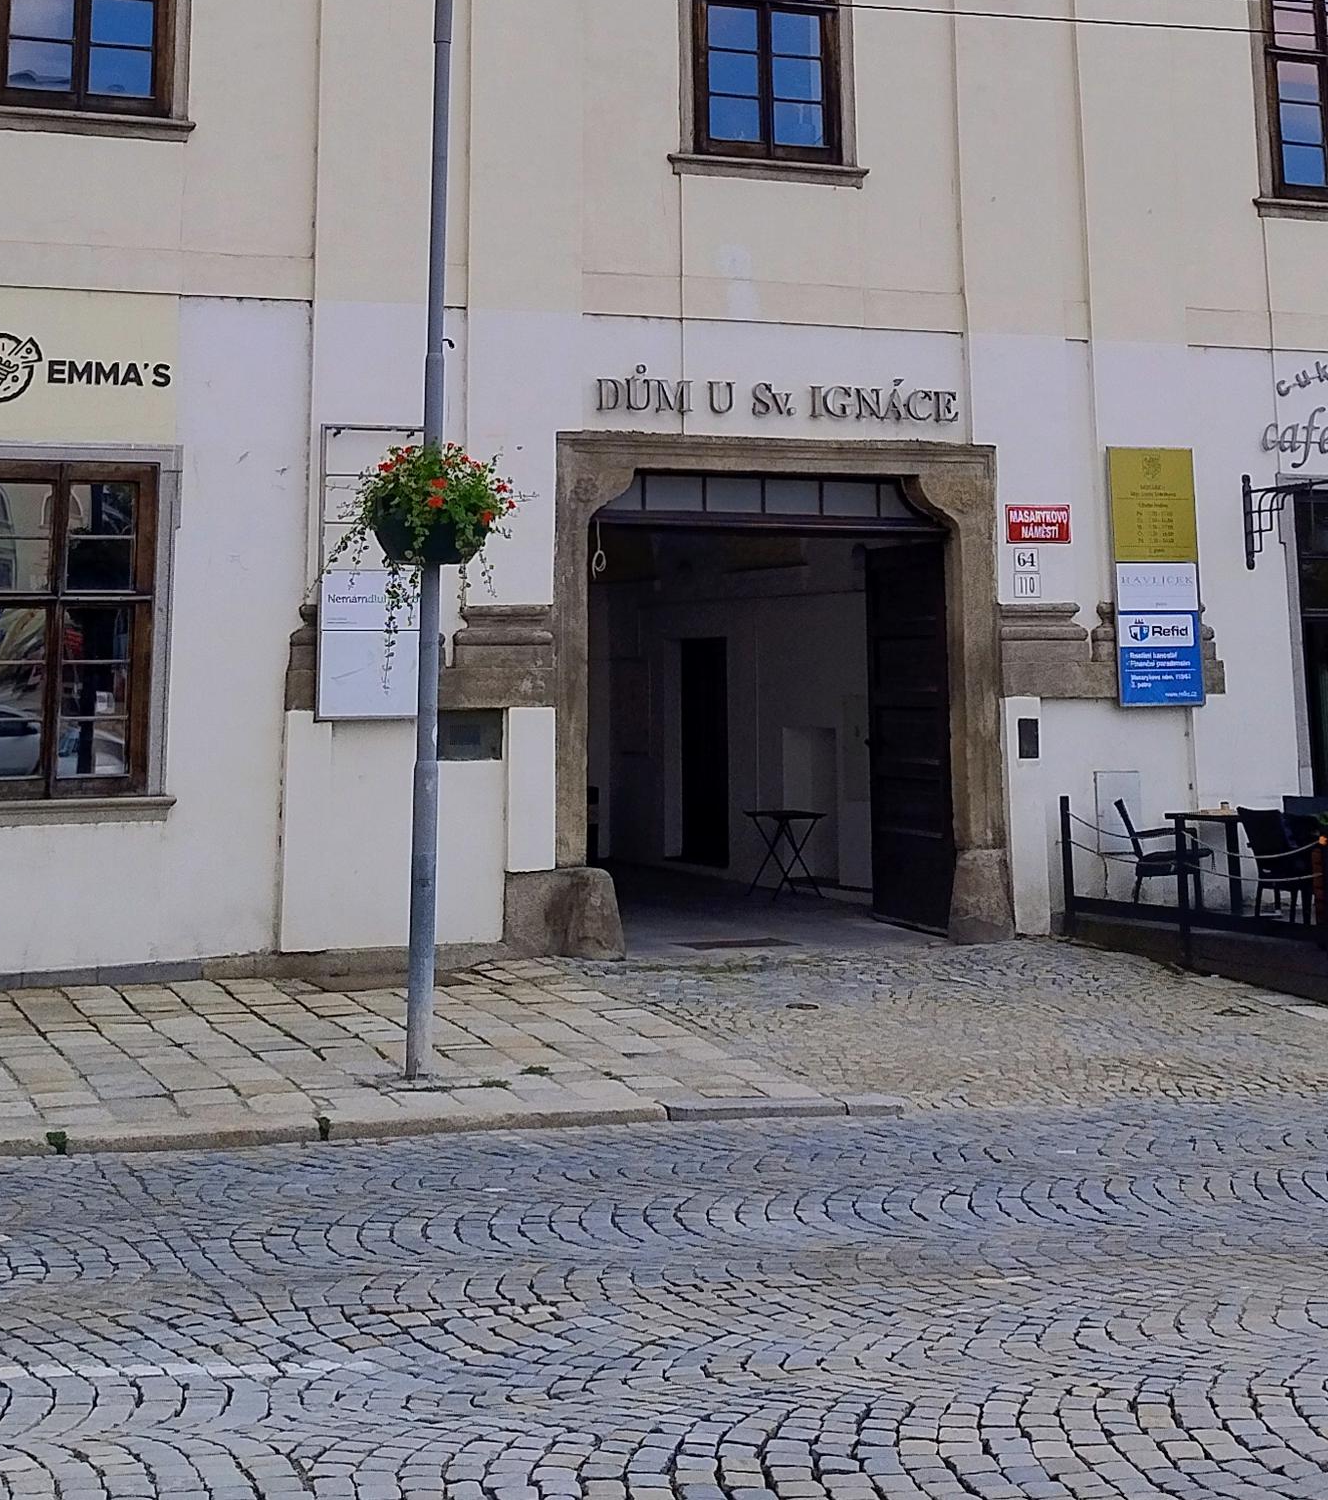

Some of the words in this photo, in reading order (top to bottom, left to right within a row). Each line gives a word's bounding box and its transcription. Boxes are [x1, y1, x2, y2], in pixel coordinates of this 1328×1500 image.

[47, 359, 171, 388] EMMA'S
[596, 363, 693, 413] DŮM
[707, 379, 736, 415] U
[750, 381, 798, 417] Sv.
[809, 377, 961, 424] IGNÁCE
[1010, 510, 1068, 525] MASARYKOVO
[1021, 523, 1059, 539] NÁMĚSTÍ
[1017, 552, 1036, 567] 64
[1019, 576, 1035, 595] 110
